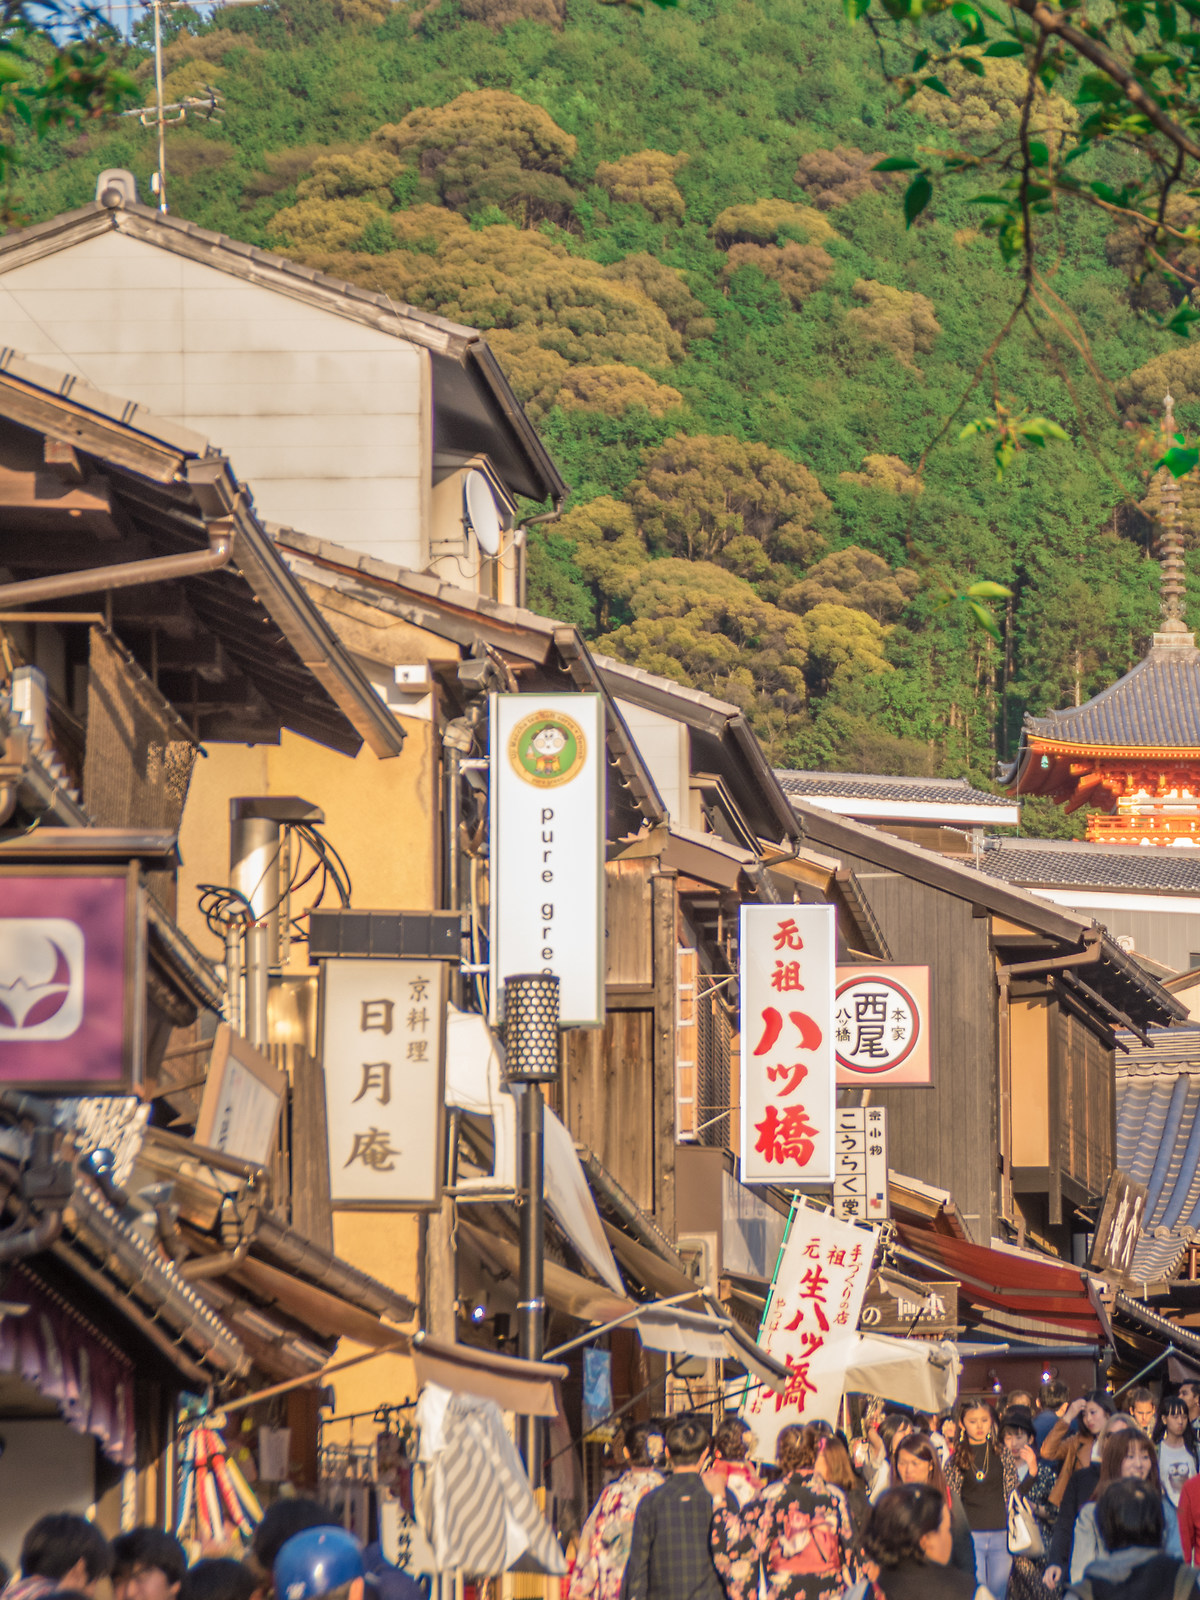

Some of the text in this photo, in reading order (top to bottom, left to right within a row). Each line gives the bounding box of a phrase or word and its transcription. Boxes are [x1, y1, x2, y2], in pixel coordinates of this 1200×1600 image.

[541, 808, 554, 882] pure
[406, 976, 430, 1063] 京料理
[850, 992, 890, 1058] 西尾
[891, 1007, 907, 1041] 本家
[342, 998, 402, 1172] 日月庵
[840, 1113, 859, 1216] こうらく堂
[868, 1110, 883, 1156] 京小物
[802, 1238, 847, 1268] 元祖
[833, 1244, 863, 1325] 手づくりの店
